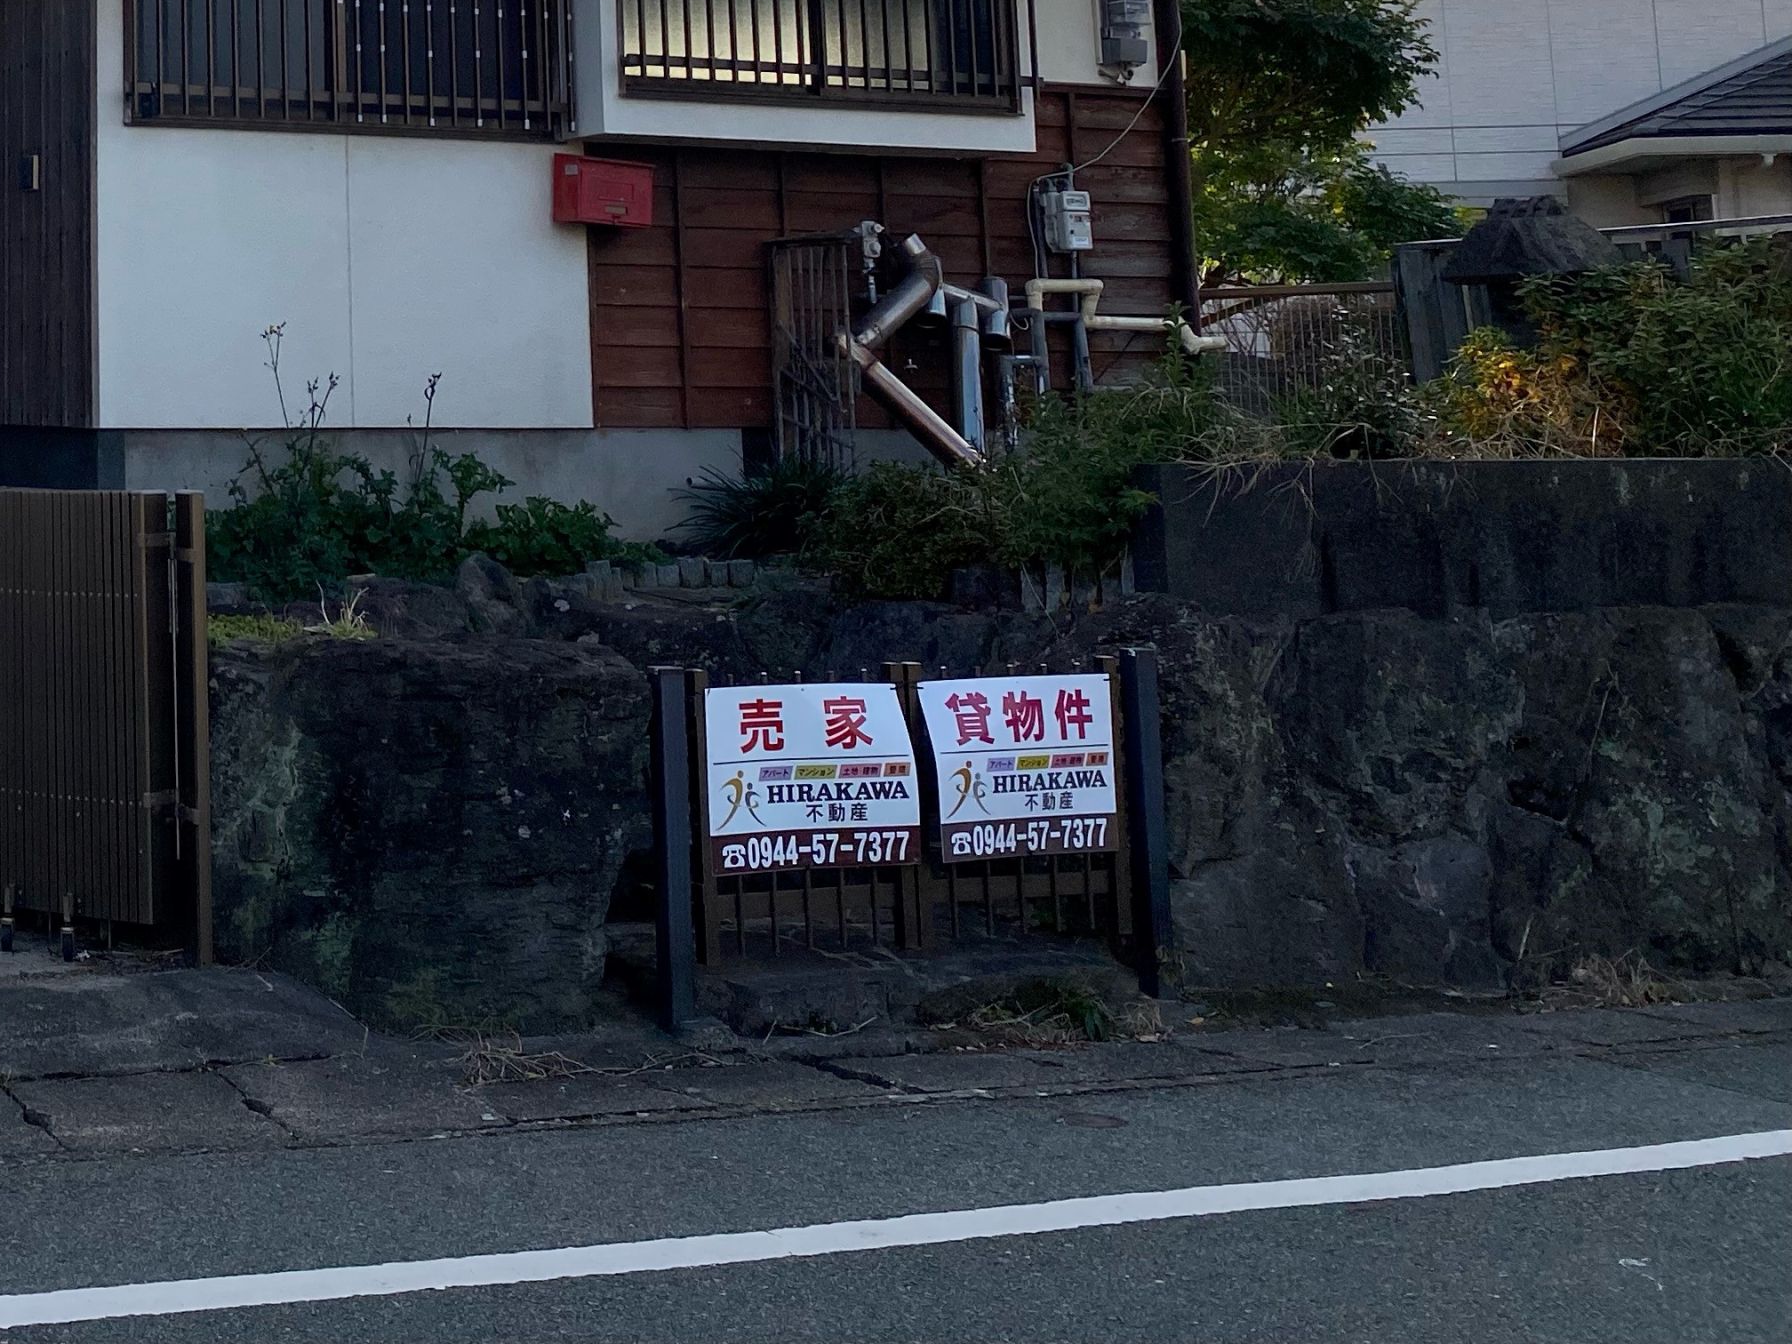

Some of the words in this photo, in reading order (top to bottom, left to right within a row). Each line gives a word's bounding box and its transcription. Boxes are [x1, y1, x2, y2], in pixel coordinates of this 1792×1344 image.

[738, 695, 874, 754] 売家
[944, 688, 1093, 746] 貸物件
[762, 768, 789, 778] アパート
[797, 767, 834, 777] マンション
[992, 769, 1108, 794] HIRAKAWA
[766, 780, 910, 804] HIRAKAWA
[1024, 791, 1074, 812] 不動産
[805, 802, 869, 824] 不動産
[972, 817, 1108, 856] 0944-57-7377
[747, 831, 910, 870] 0944-57-7377
